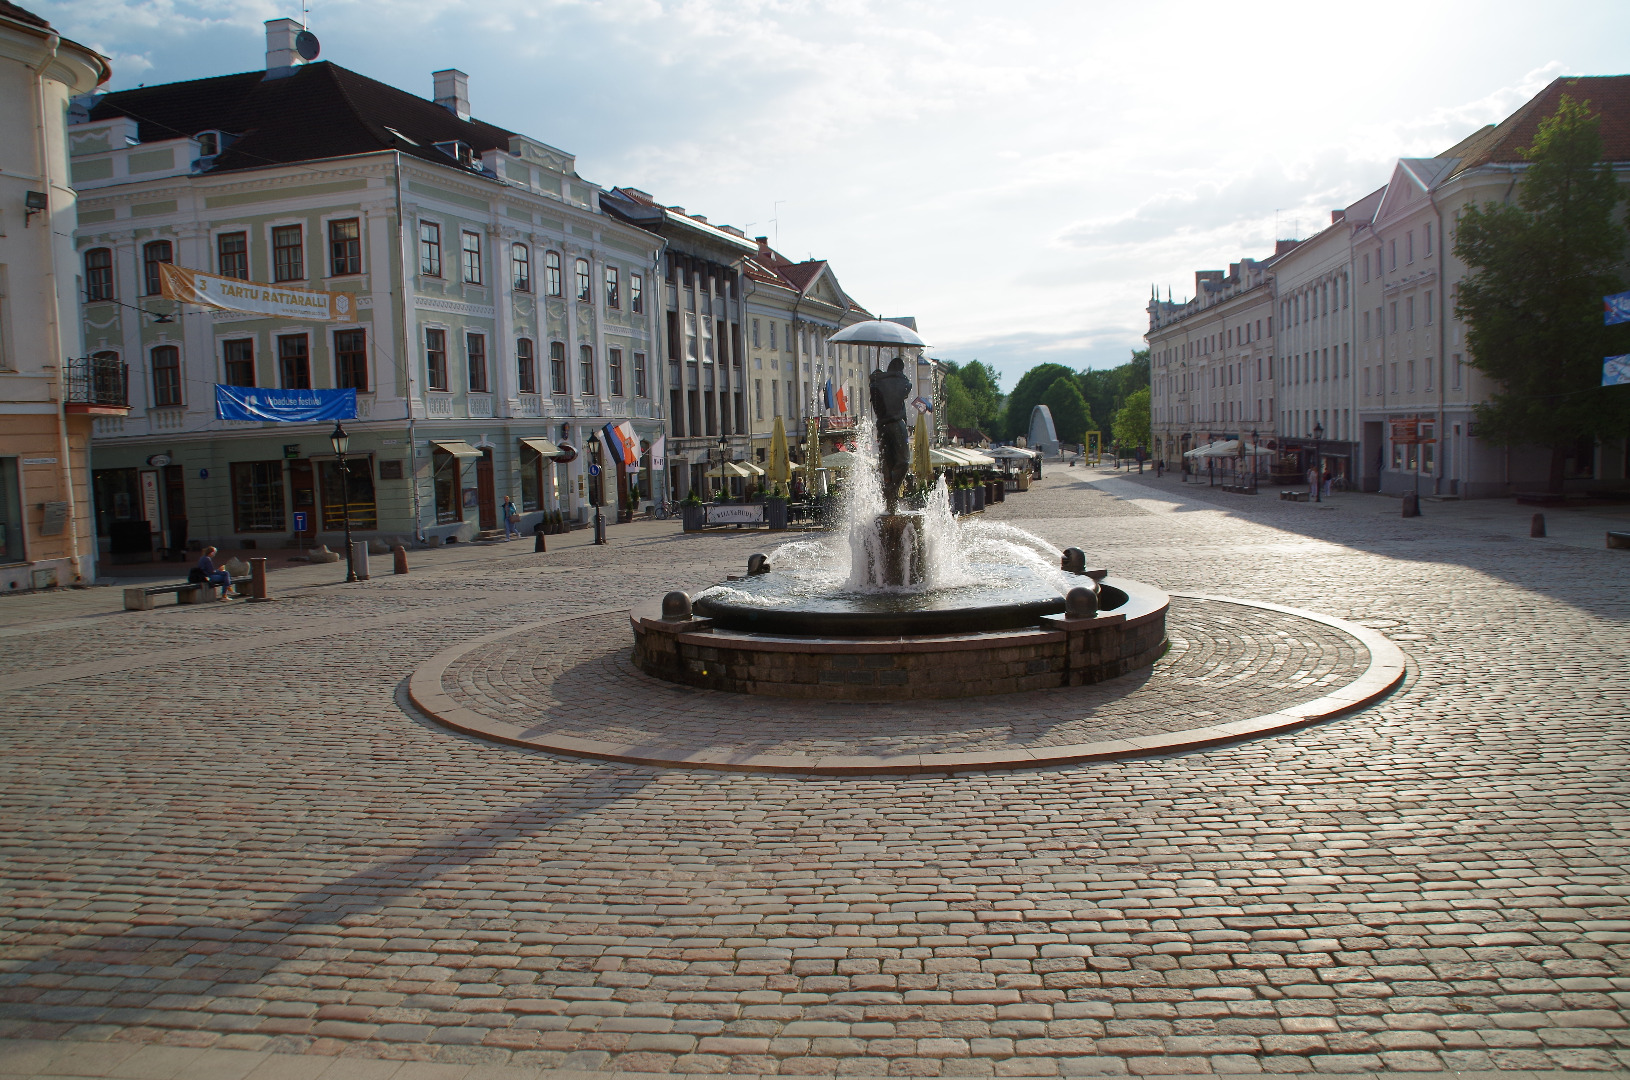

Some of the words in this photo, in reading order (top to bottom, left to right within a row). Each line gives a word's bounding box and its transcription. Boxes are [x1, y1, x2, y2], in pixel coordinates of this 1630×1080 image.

[220, 283, 259, 300] TARTU
[262, 290, 327, 309] RATTARALLI
[264, 396, 297, 406] Vbaduse
[298, 396, 322, 406] festival
